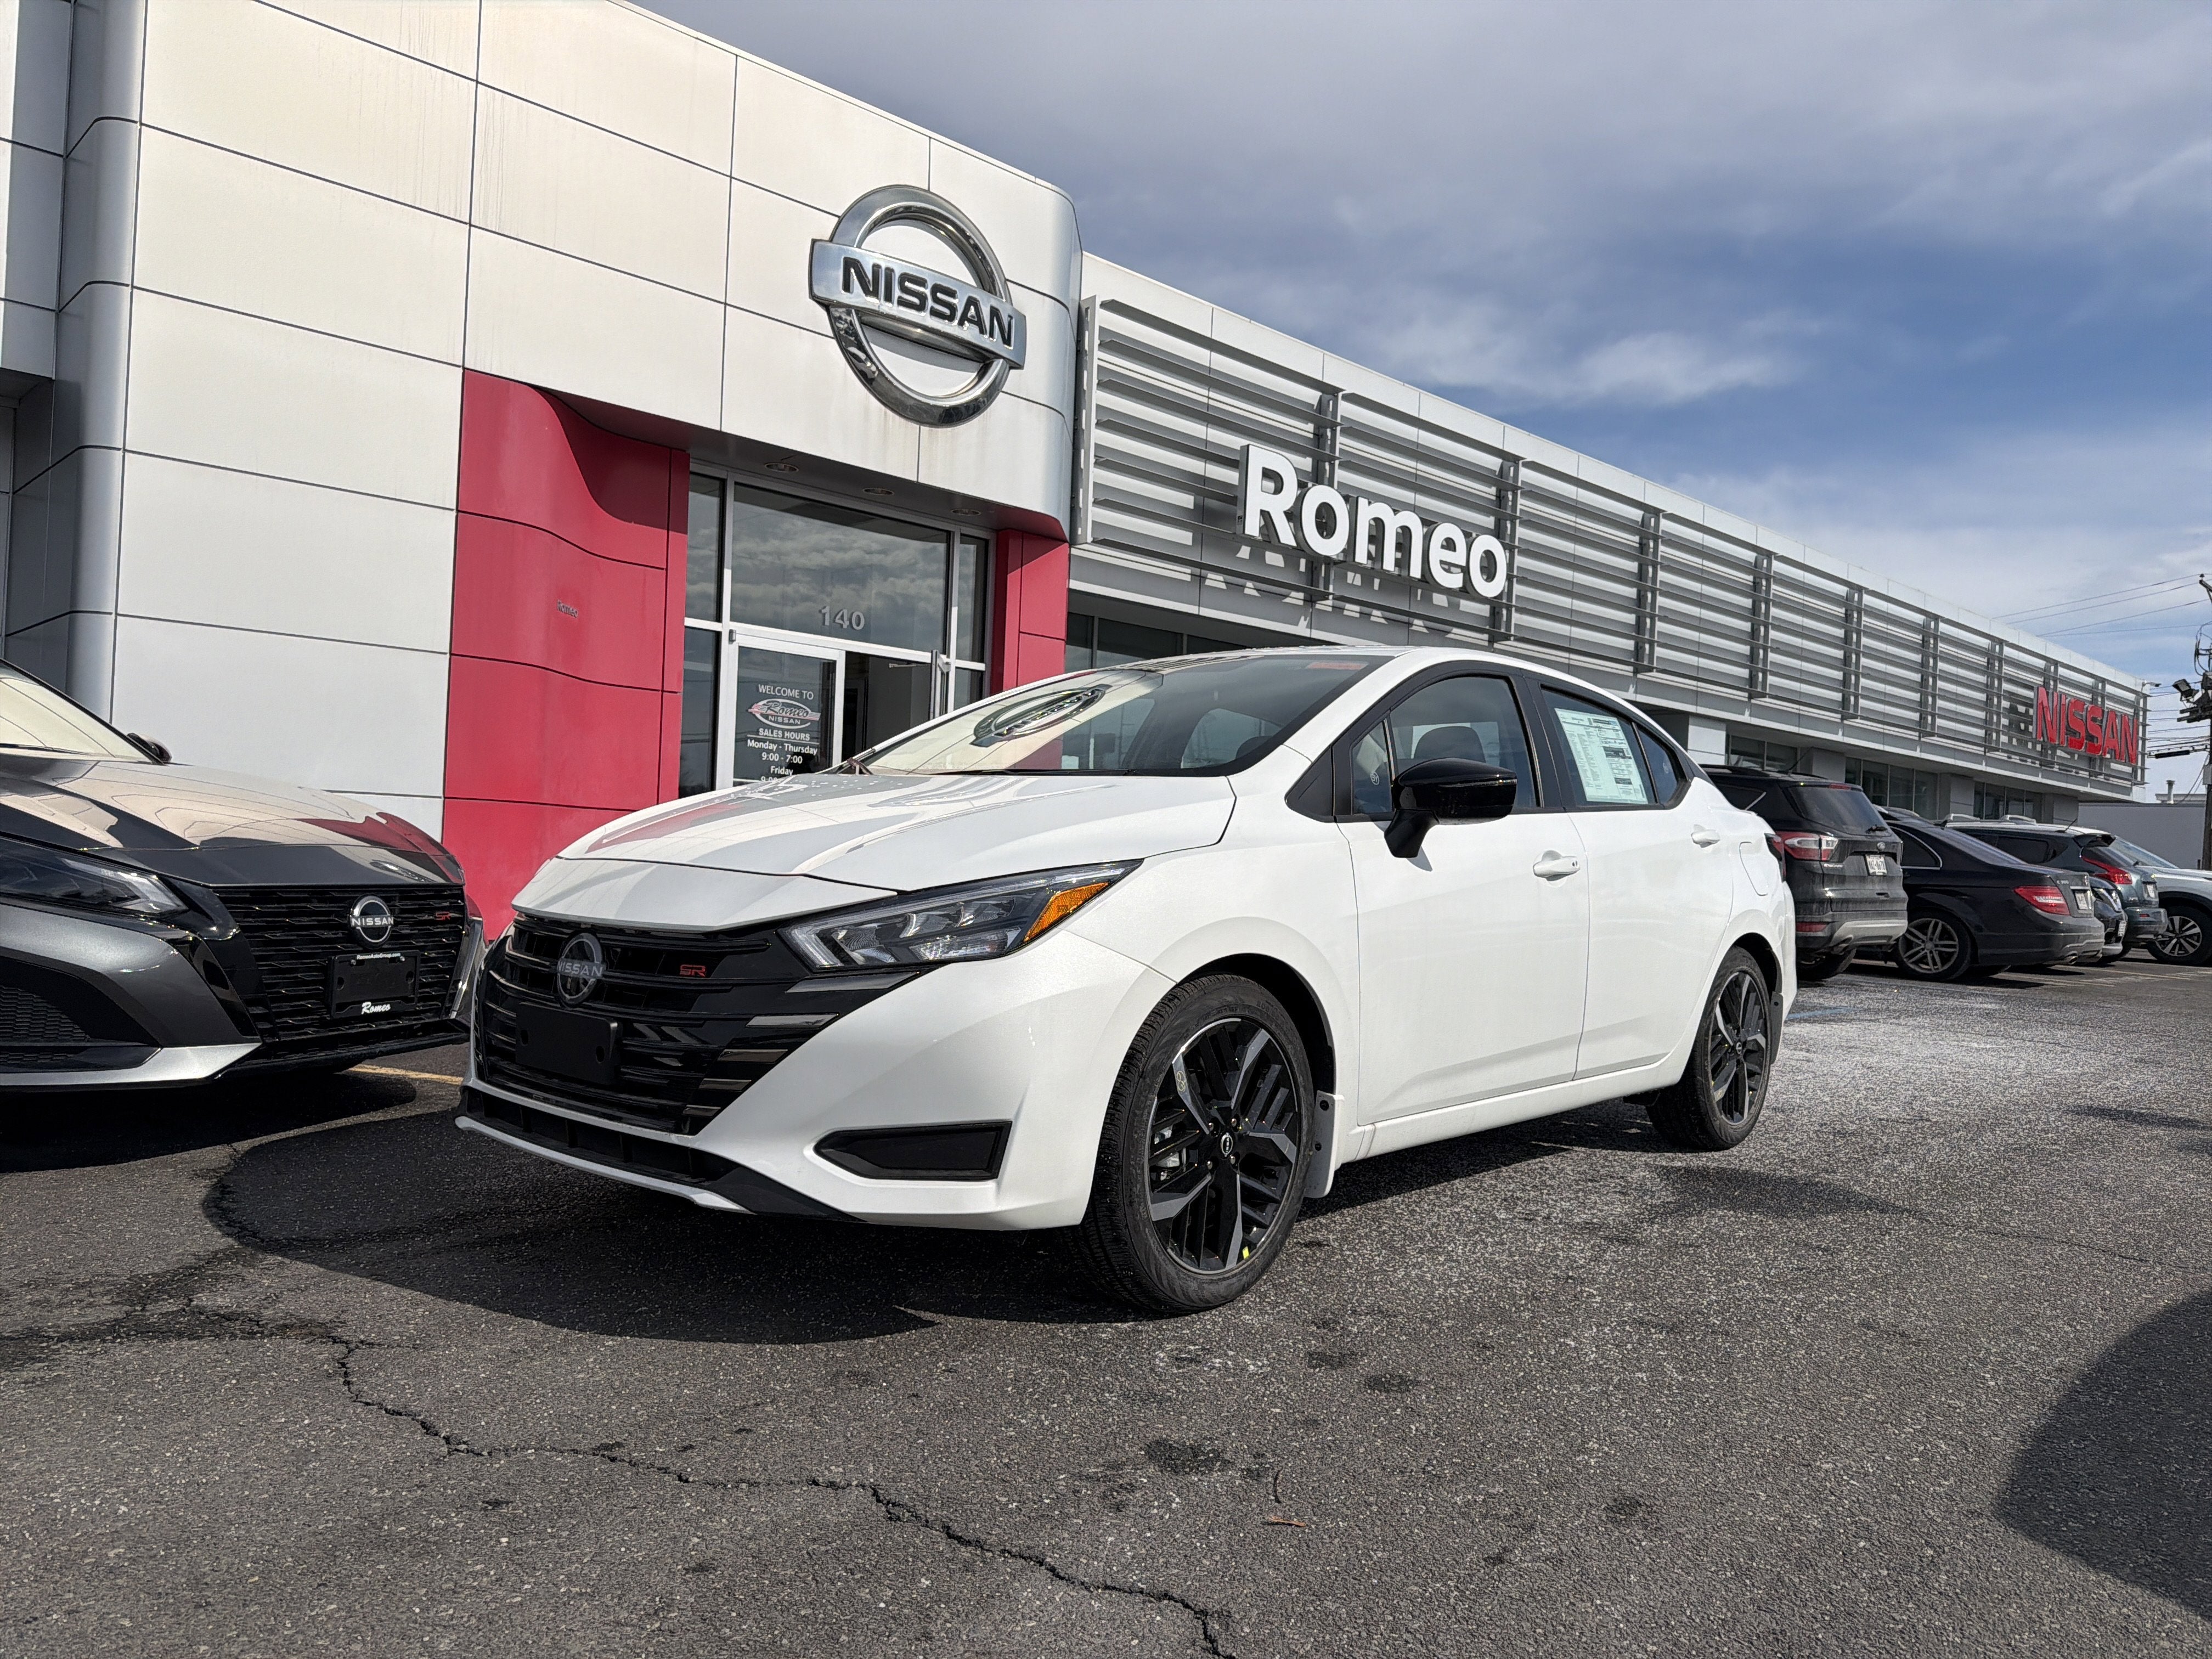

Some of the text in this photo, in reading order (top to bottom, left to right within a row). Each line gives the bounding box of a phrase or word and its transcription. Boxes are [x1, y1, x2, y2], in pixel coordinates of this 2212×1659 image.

[841, 256, 1014, 350] NISSAN
[1241, 444, 1508, 597] Romeo
[820, 606, 865, 630] 140
[758, 684, 814, 700] WELCOME TO
[763, 700, 809, 718] Romeo
[769, 715, 801, 725] NISSAN
[2035, 686, 2139, 764] NISSAN
[759, 728, 810, 741] SALES HOURS
[747, 739, 778, 752] Monday
[784, 743, 818, 755] Thursday
[761, 752, 779, 761] 9:00
[786, 755, 803, 764] 7:00
[771, 765, 794, 776] Friday
[352, 917, 394, 927] NISSAN
[435, 911, 452, 921] SR
[557, 960, 603, 977] NISSAN
[680, 964, 707, 977] SR
[361, 1002, 391, 1015] Romeo
